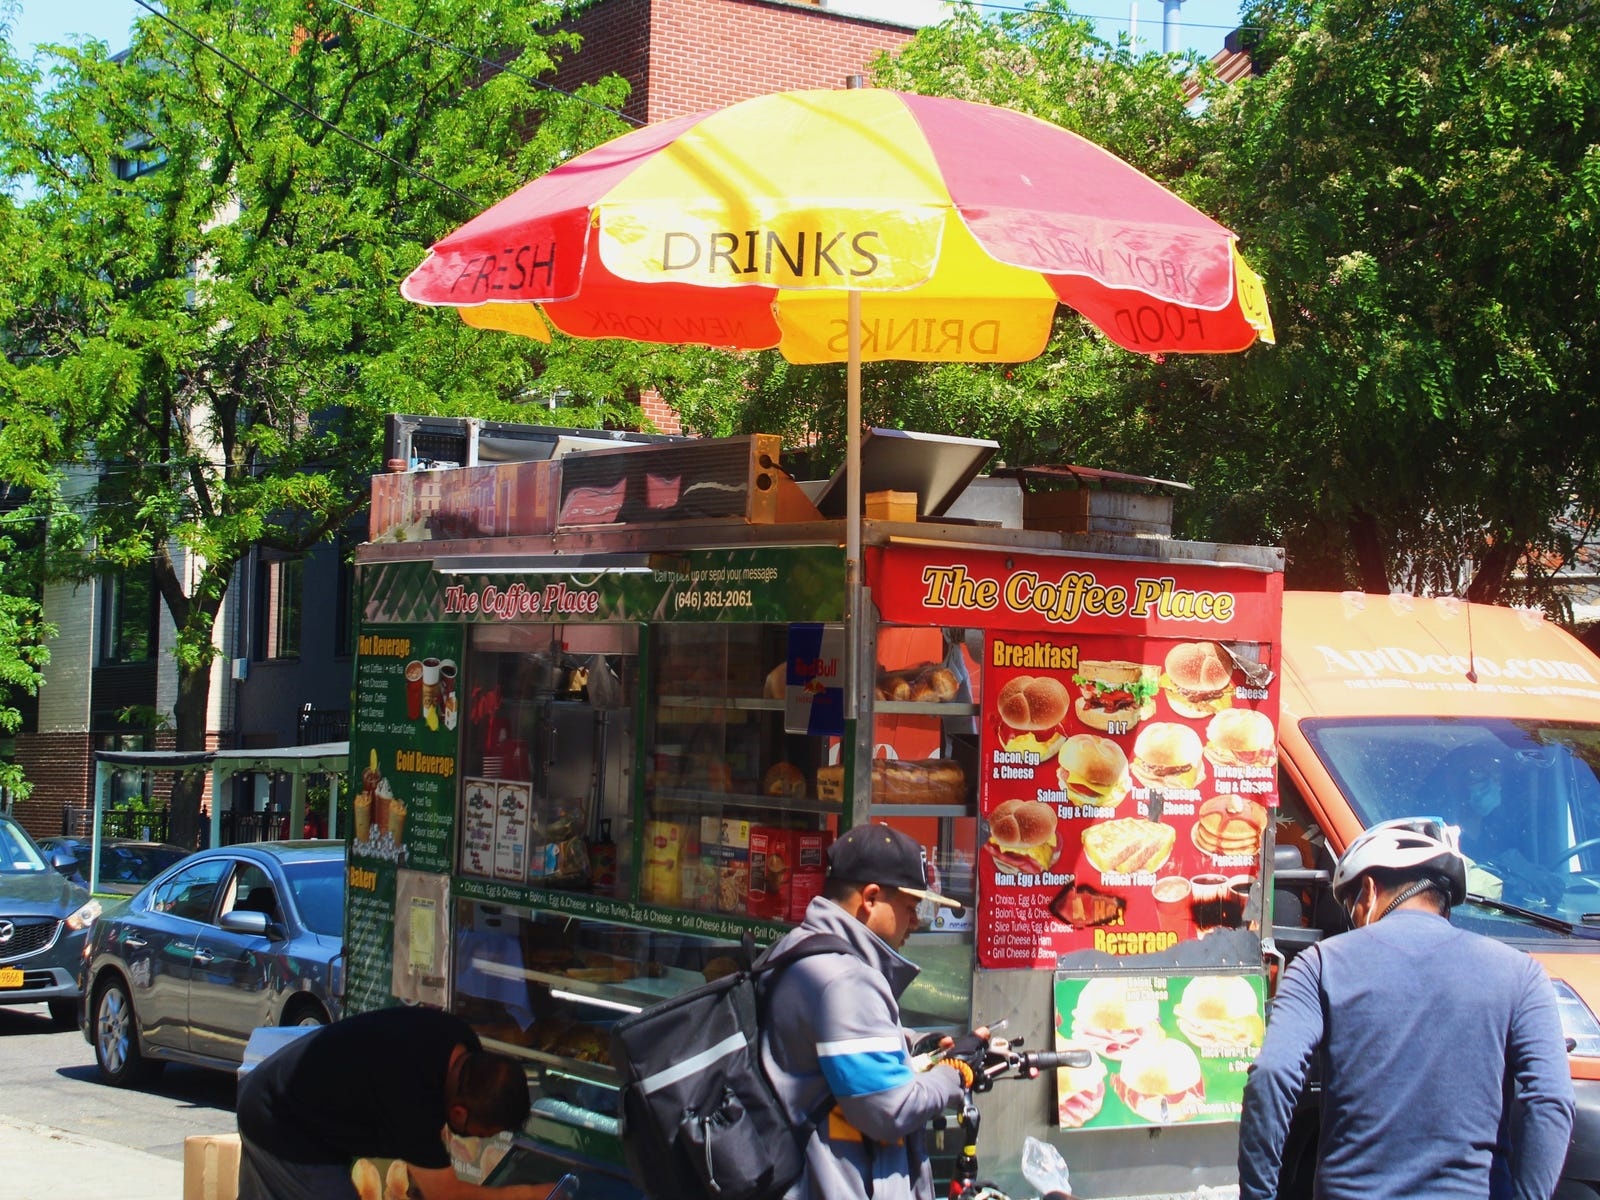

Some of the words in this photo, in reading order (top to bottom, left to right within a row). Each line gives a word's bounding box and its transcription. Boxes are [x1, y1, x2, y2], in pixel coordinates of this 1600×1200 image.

[662, 230, 881, 278] DRINKS
[450, 242, 556, 295] FRESH
[1028, 237, 1106, 277] NEW
[1114, 249, 1202, 298] YORK
[701, 569, 709, 581] or
[709, 566, 725, 581] send
[727, 568, 742, 583] your
[742, 567, 778, 582] messages
[444, 582, 479, 614] The
[481, 582, 542, 620] Coffee
[541, 582, 600, 614] Place
[675, 591, 702, 611] (646)
[703, 590, 753, 607] 361-2061
[922, 564, 997, 612] The
[1004, 570, 1129, 626] Coffee
[1131, 578, 1236, 622] Place
[373, 635, 411, 658] Beverage
[993, 640, 1080, 671] Breakfast
[1235, 686, 1269, 701] Cheese
[1107, 721, 1128, 735] BLT
[396, 750, 415, 772] Cold
[416, 751, 455, 778] Beverage
[993, 750, 1024, 765] Bacon,
[1024, 751, 1040, 766] Egg
[993, 767, 1000, 778] &
[1001, 766, 1034, 780] Cheese
[1232, 781, 1239, 793] &
[1037, 789, 1068, 802] Salami,
[1058, 806, 1073, 819] Egg
[1074, 806, 1081, 818] &
[1082, 807, 1116, 819] Cheese
[350, 865, 377, 892] Bakery
[995, 872, 1017, 887] Ham,
[1017, 872, 1034, 887] Egg
[1034, 873, 1041, 886] &
[1042, 872, 1075, 886] Cheese
[1018, 894, 1029, 907] Egg
[1030, 894, 1036, 905] &
[643, 909, 649, 919] &
[650, 910, 673, 925] Cheese
[1027, 908, 1033, 919] &
[682, 914, 694, 927] Grill
[695, 917, 719, 932] Cheese
[720, 921, 726, 932] &
[728, 922, 744, 935] Ham
[753, 926, 767, 939] Grill
[995, 921, 1009, 932] Slice
[1031, 921, 1043, 934] Egg
[1044, 921, 1049, 932] &
[993, 934, 1006, 945] Grill
[1007, 934, 1031, 945] Cheese
[1032, 935, 1038, 945] &
[1038, 935, 1052, 946] Ham
[992, 947, 1005, 958] Grill
[1006, 947, 1030, 958] Cheese
[1031, 948, 1037, 958] &
